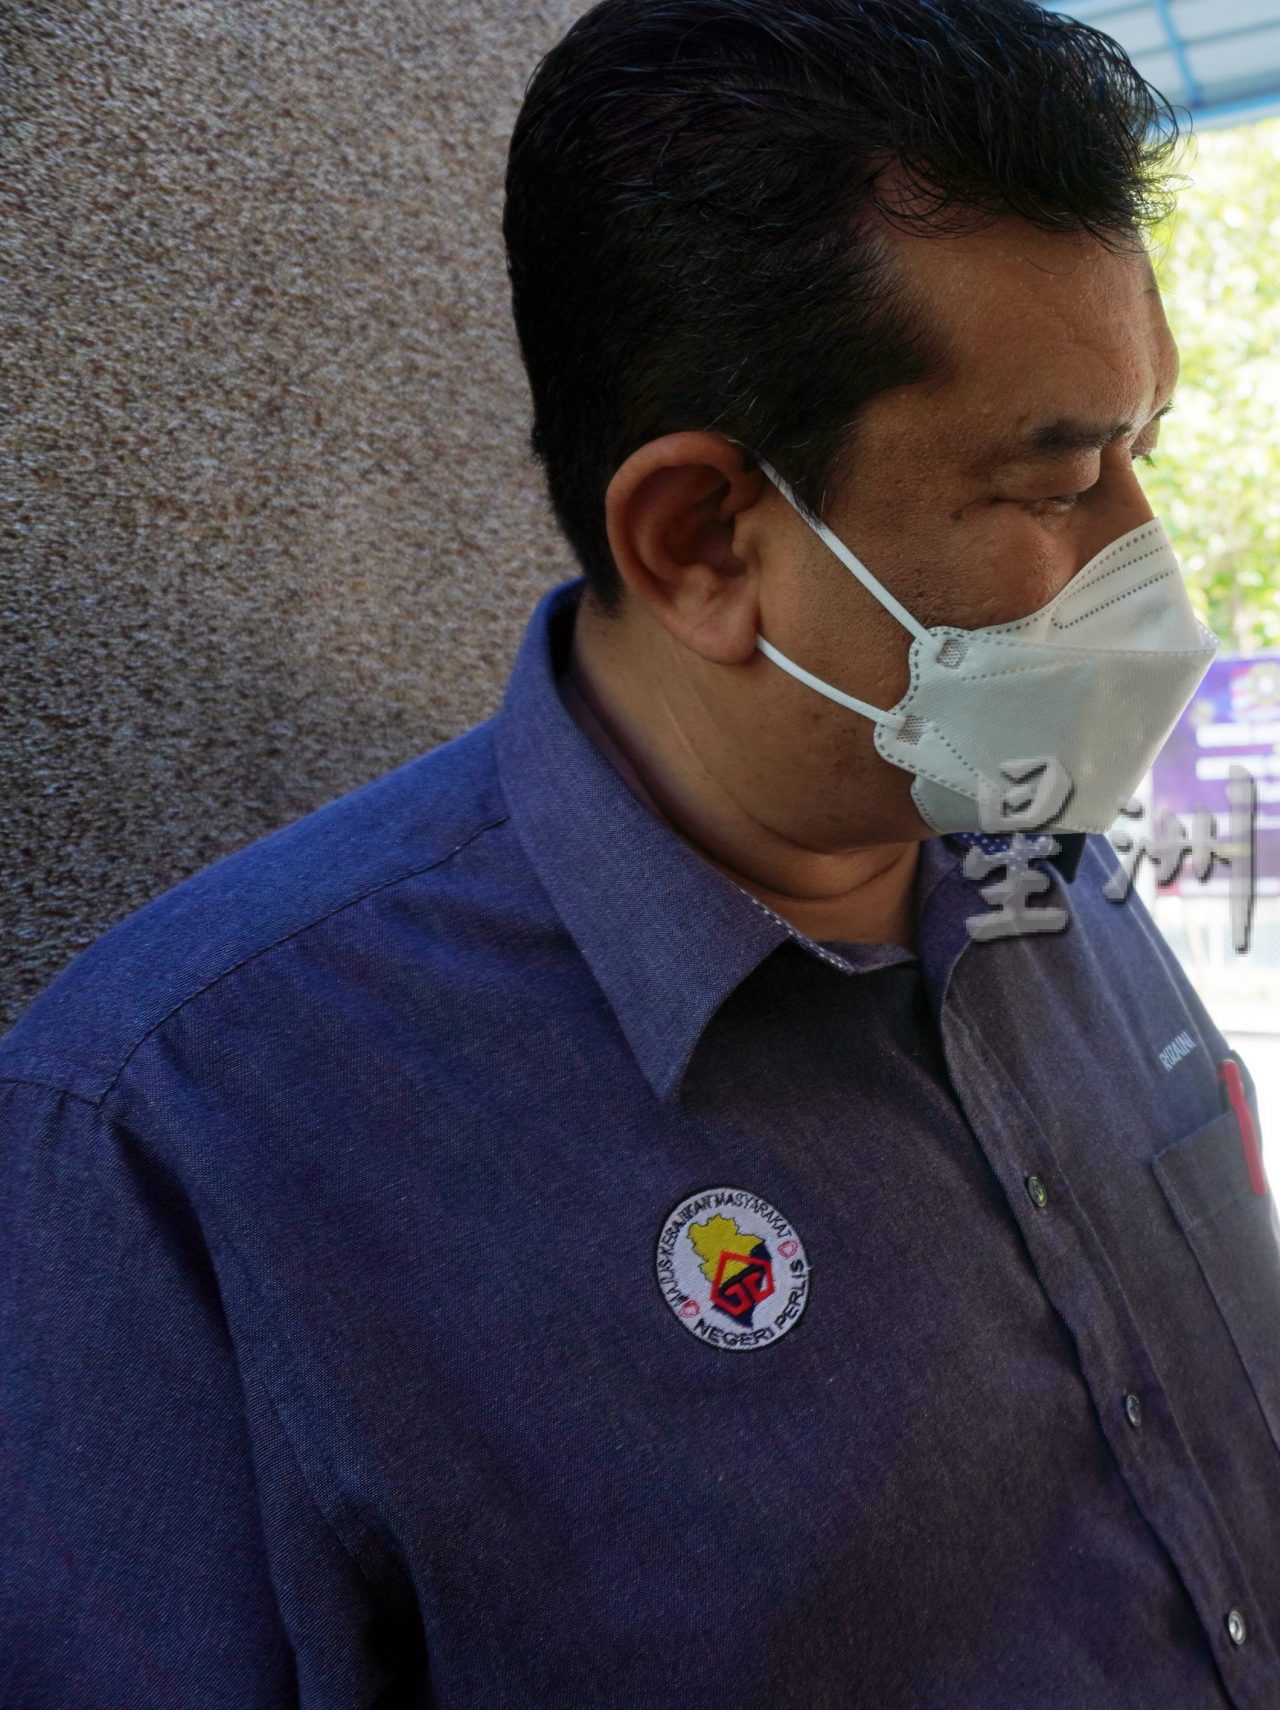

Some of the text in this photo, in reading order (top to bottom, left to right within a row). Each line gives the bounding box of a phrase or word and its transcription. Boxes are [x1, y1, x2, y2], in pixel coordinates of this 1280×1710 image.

[1158, 1031, 1197, 1072] RUZAINI
[713, 1191, 793, 1238] MASYARAKAT
[693, 1258, 805, 1346] NEGERI PERLIS
